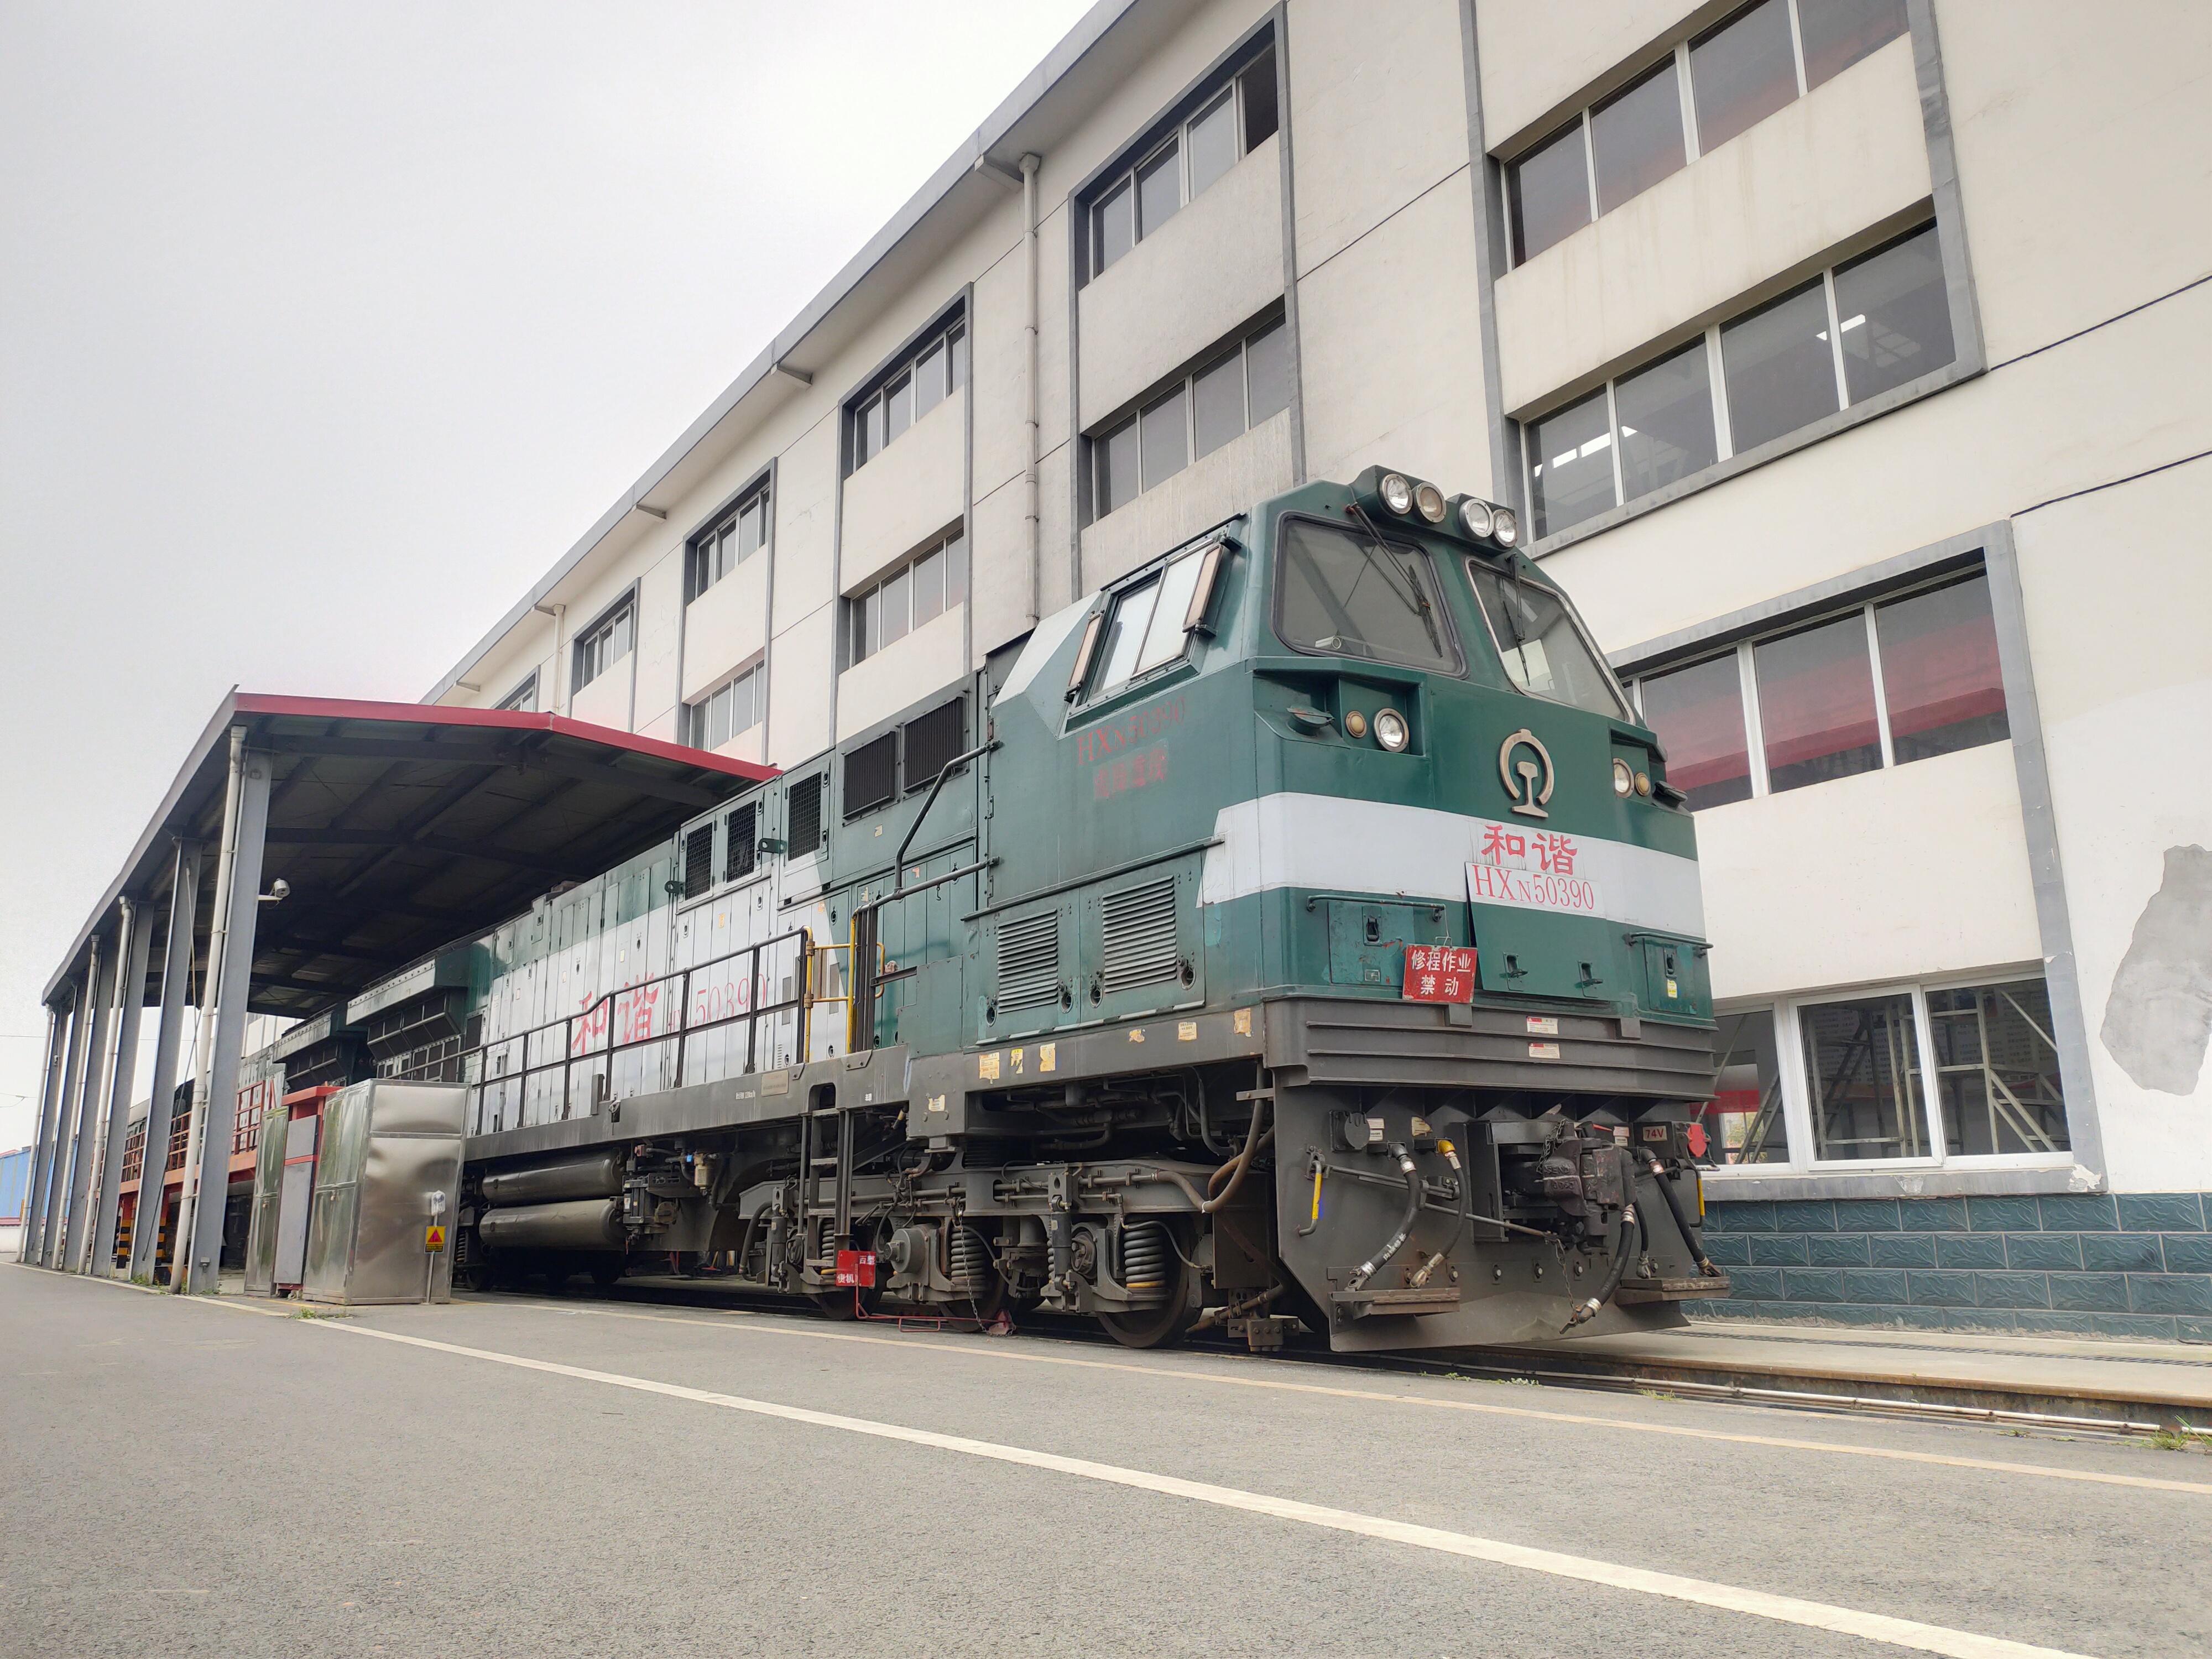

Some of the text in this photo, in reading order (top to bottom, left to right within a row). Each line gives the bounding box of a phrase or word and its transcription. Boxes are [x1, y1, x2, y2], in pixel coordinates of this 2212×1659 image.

[1077, 696, 1185, 766] HXN50390
[1481, 824, 1578, 875] 和谐
[1472, 864, 1594, 910] HXN50390
[1411, 950, 1471, 972] 修程作业
[1420, 974, 1459, 996] 禁动
[571, 972, 659, 1056] 和谐
[1645, 1128, 1664, 1139] 74V
